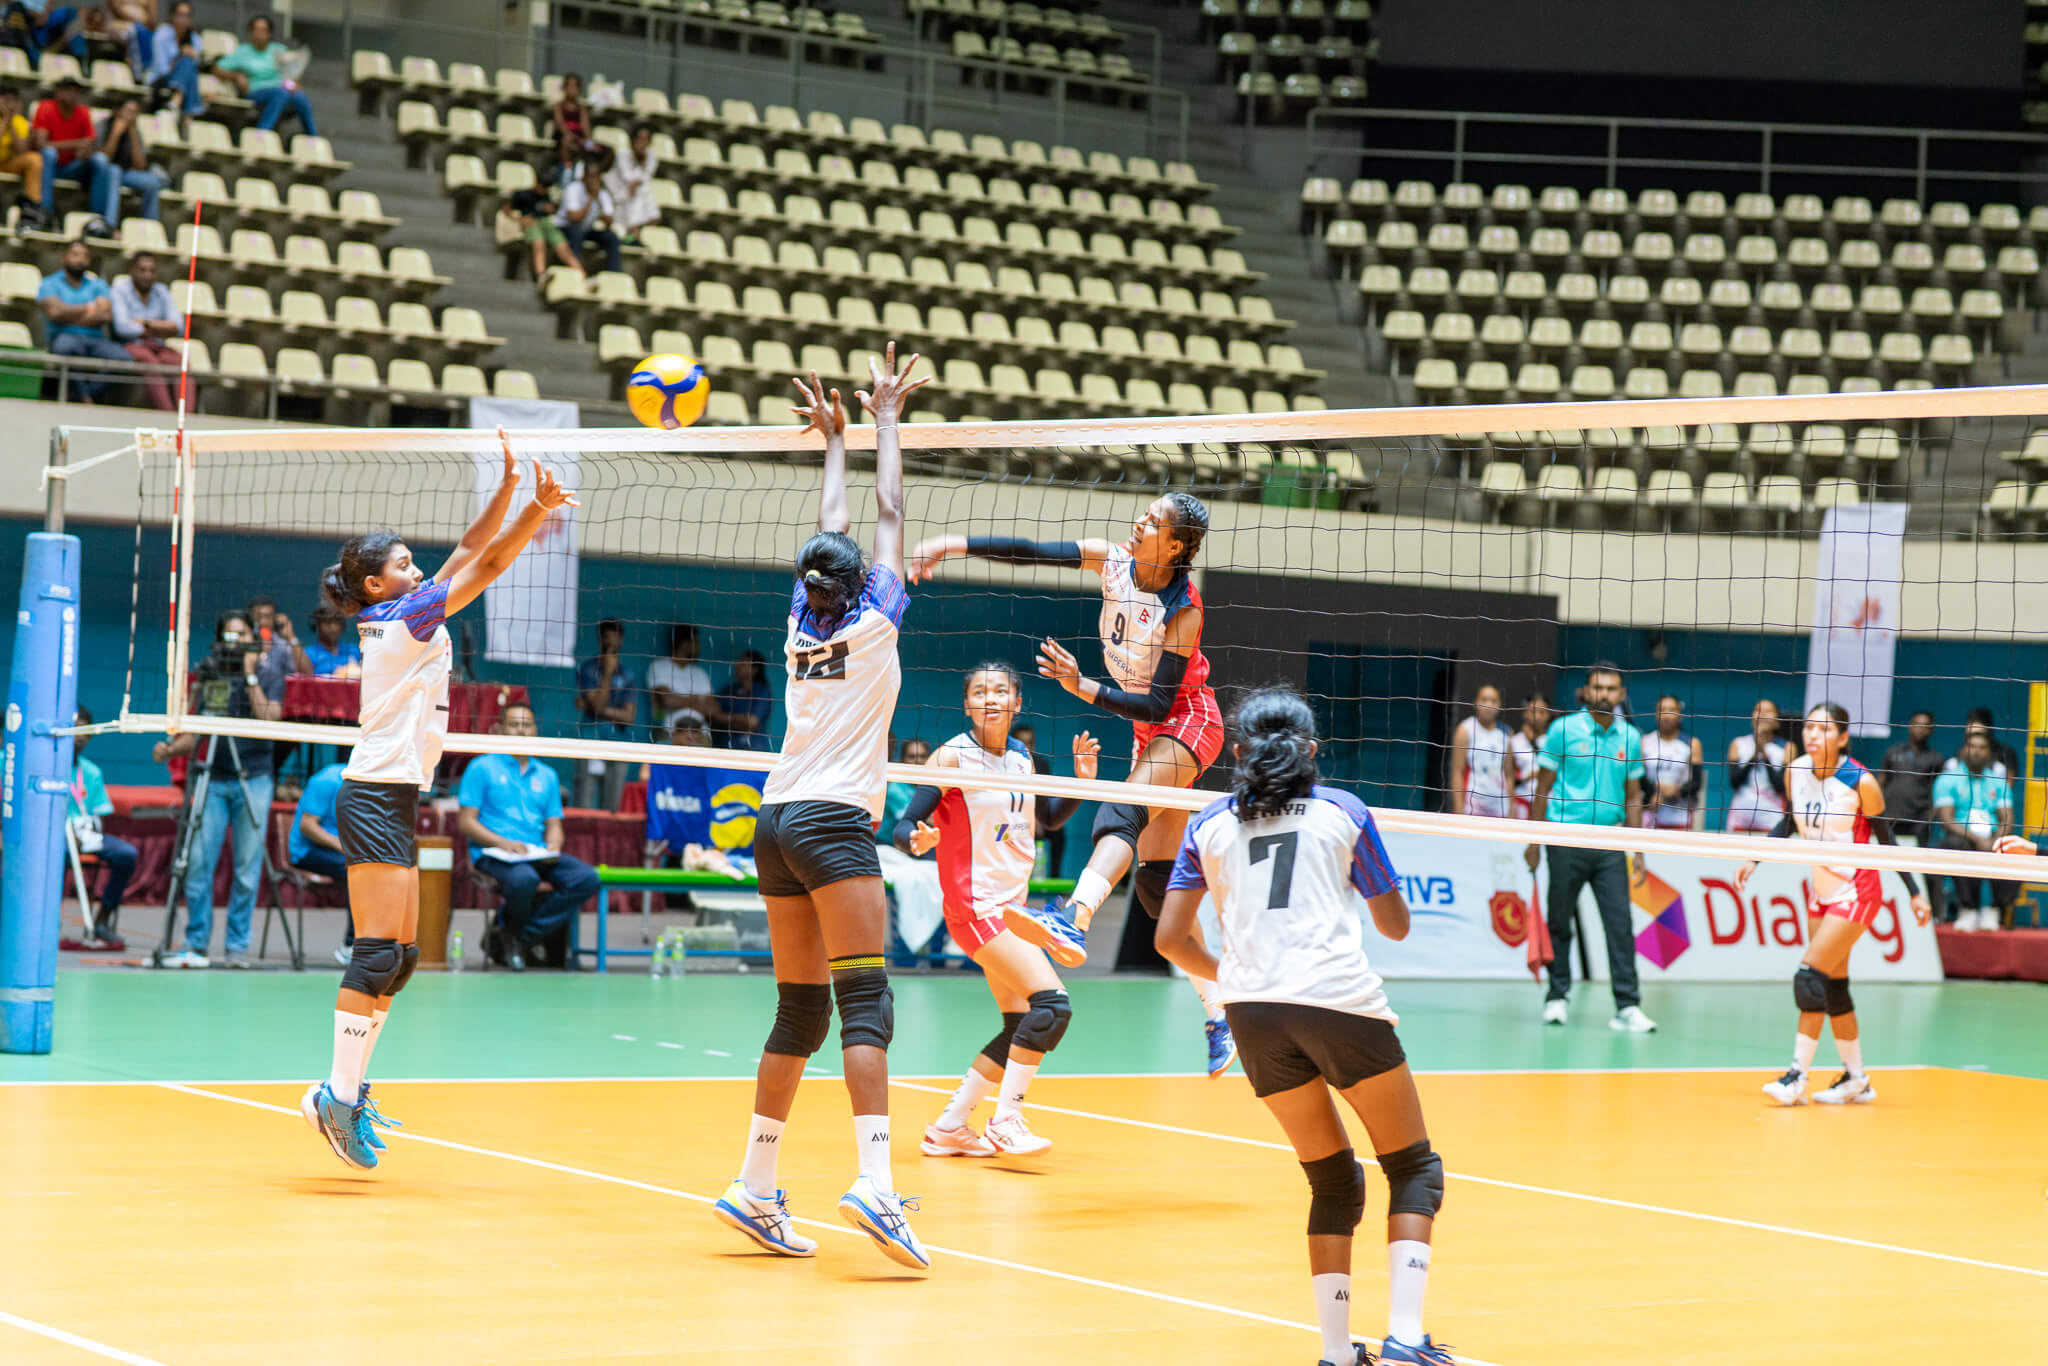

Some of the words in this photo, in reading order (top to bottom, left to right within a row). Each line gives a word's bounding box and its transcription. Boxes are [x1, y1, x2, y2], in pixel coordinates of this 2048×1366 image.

[1111, 612, 1126, 646] 9
[795, 640, 850, 681] 12
[1106, 649, 1137, 678] IMPERIAL
[1010, 791, 1024, 813] 11
[1805, 801, 1822, 829] 12
[1248, 831, 1298, 910] 7
[1699, 877, 1905, 963] Diag
